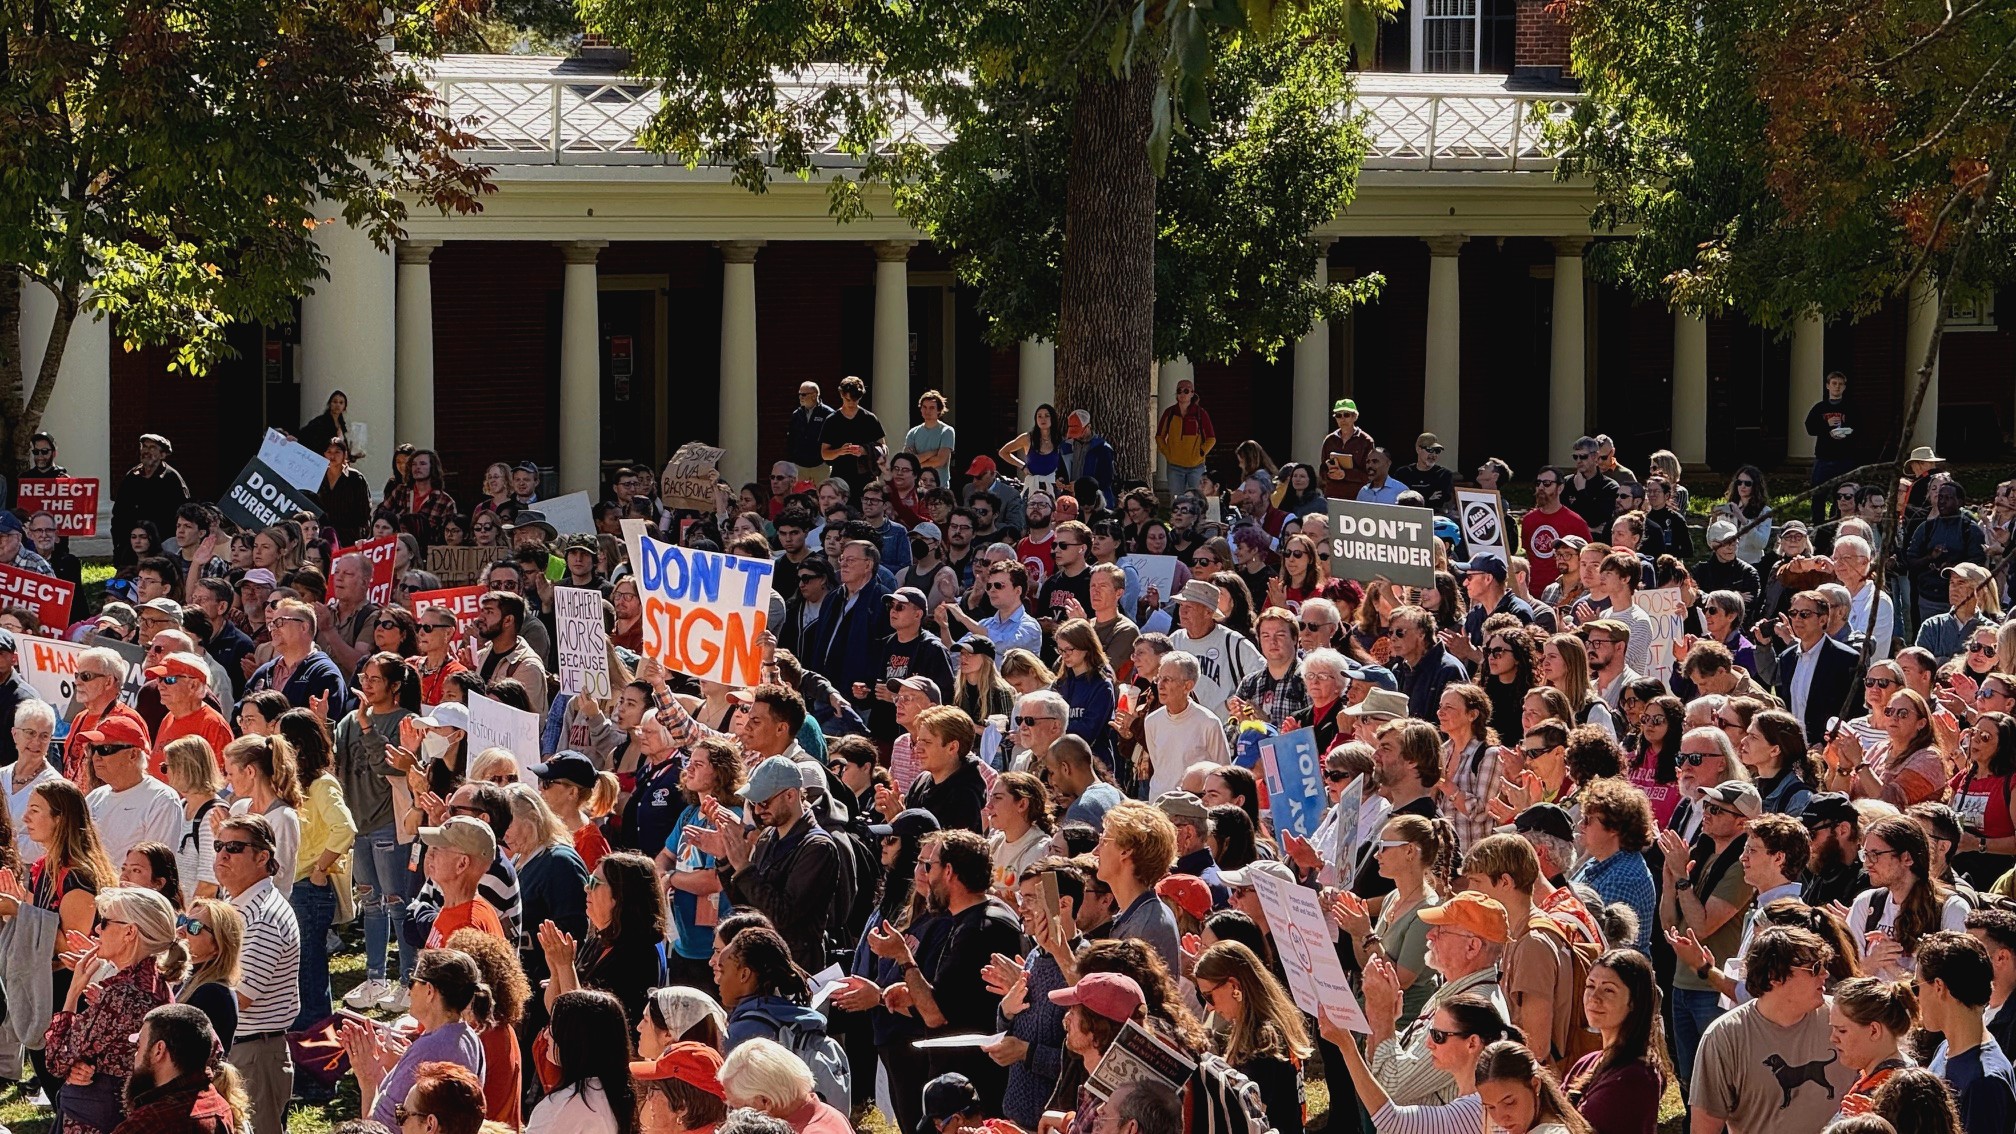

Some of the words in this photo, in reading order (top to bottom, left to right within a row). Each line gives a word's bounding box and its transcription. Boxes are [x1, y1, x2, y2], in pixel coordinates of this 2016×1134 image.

[676, 464, 700, 479] UVA
[20, 483, 96, 497] REJECT
[663, 478, 714, 499] BACKBONE
[41, 500, 74, 510] THE
[230, 485, 281, 528] SURREN
[1469, 509, 1486, 525] Just
[54, 514, 94, 530] PACT
[1339, 515, 1422, 542] DON'T
[1485, 519, 1495, 529] no
[1333, 538, 1432, 567] SURRENDER
[640, 535, 773, 607] DON'T
[558, 618, 605, 664] WORKS
[643, 597, 767, 687] SIGN
[560, 652, 607, 671] BECAUSE
[560, 668, 582, 693] WE
[584, 670, 609, 697] DO
[469, 710, 496, 746] History
[499, 731, 512, 750] will
[1288, 798, 1307, 834] AY
